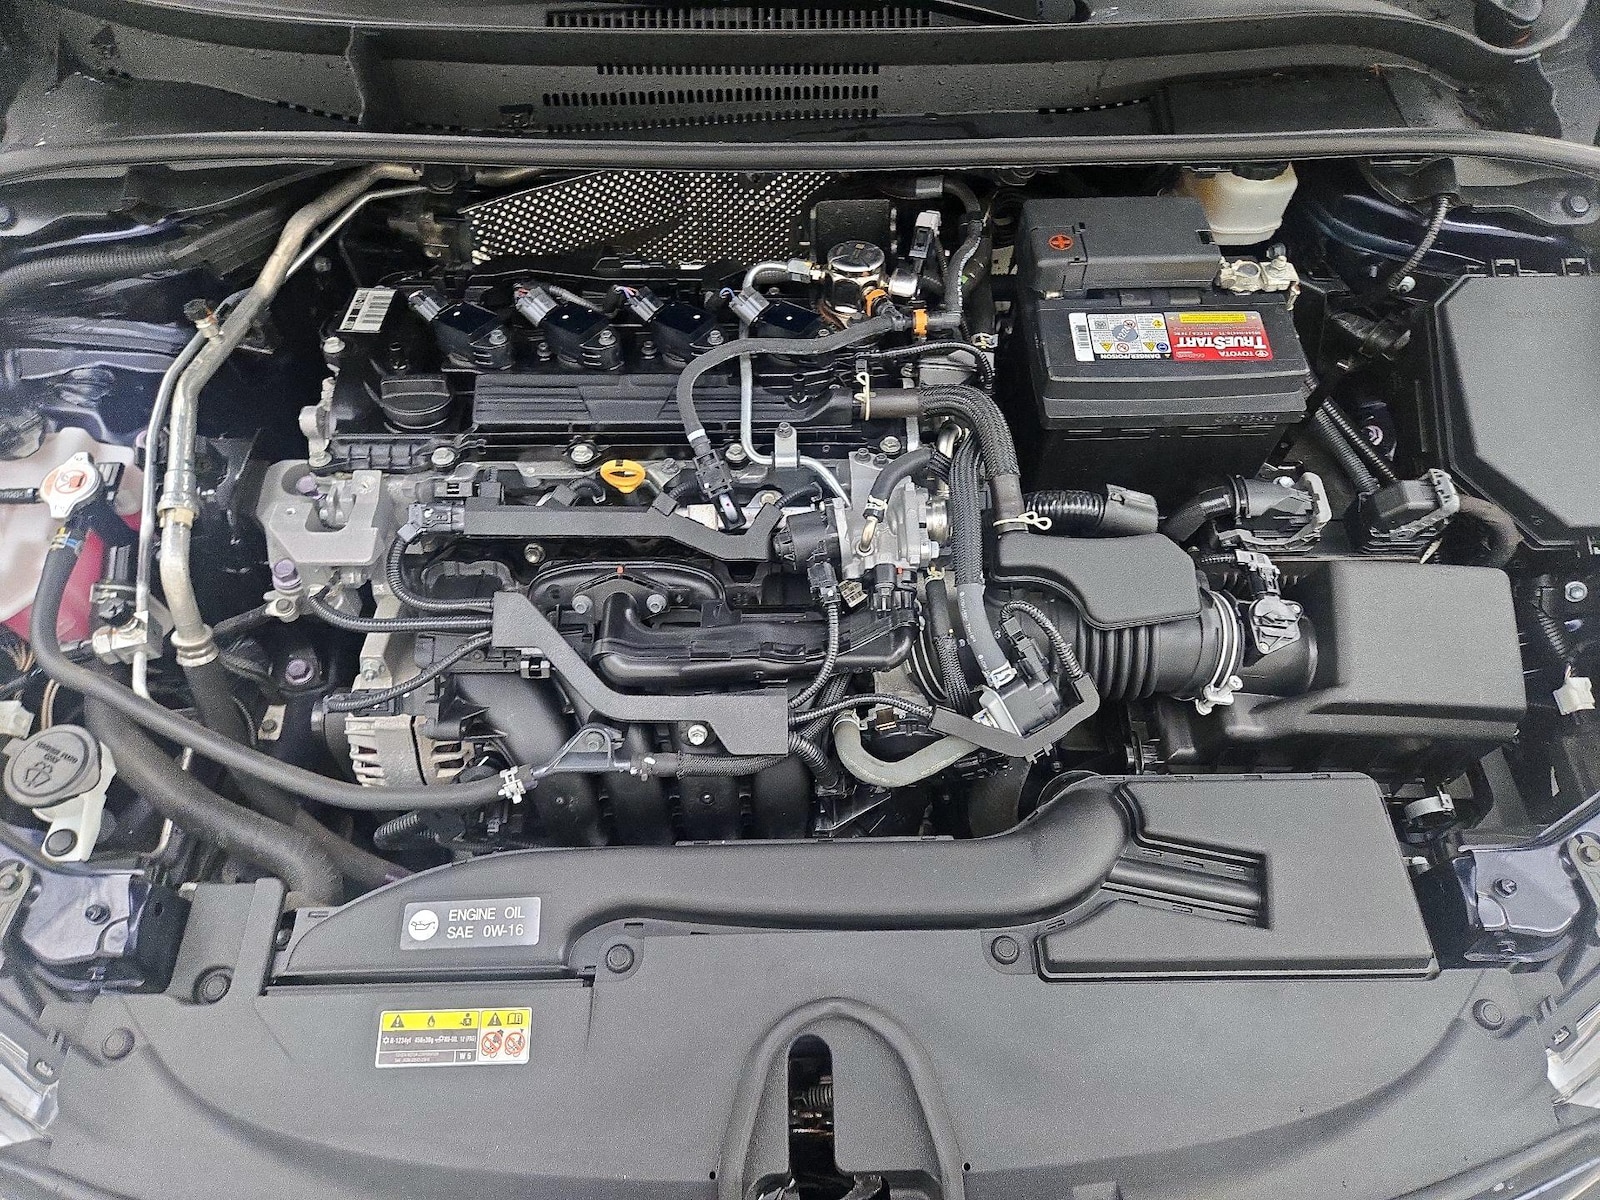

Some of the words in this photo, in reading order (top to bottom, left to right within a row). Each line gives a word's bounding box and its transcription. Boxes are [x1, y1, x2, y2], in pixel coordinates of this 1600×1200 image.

[448, 907, 497, 922] ENGINE
[504, 906, 526, 919] OIL
[446, 925, 474, 939] SAE
[483, 923, 524, 938] 0W-16
